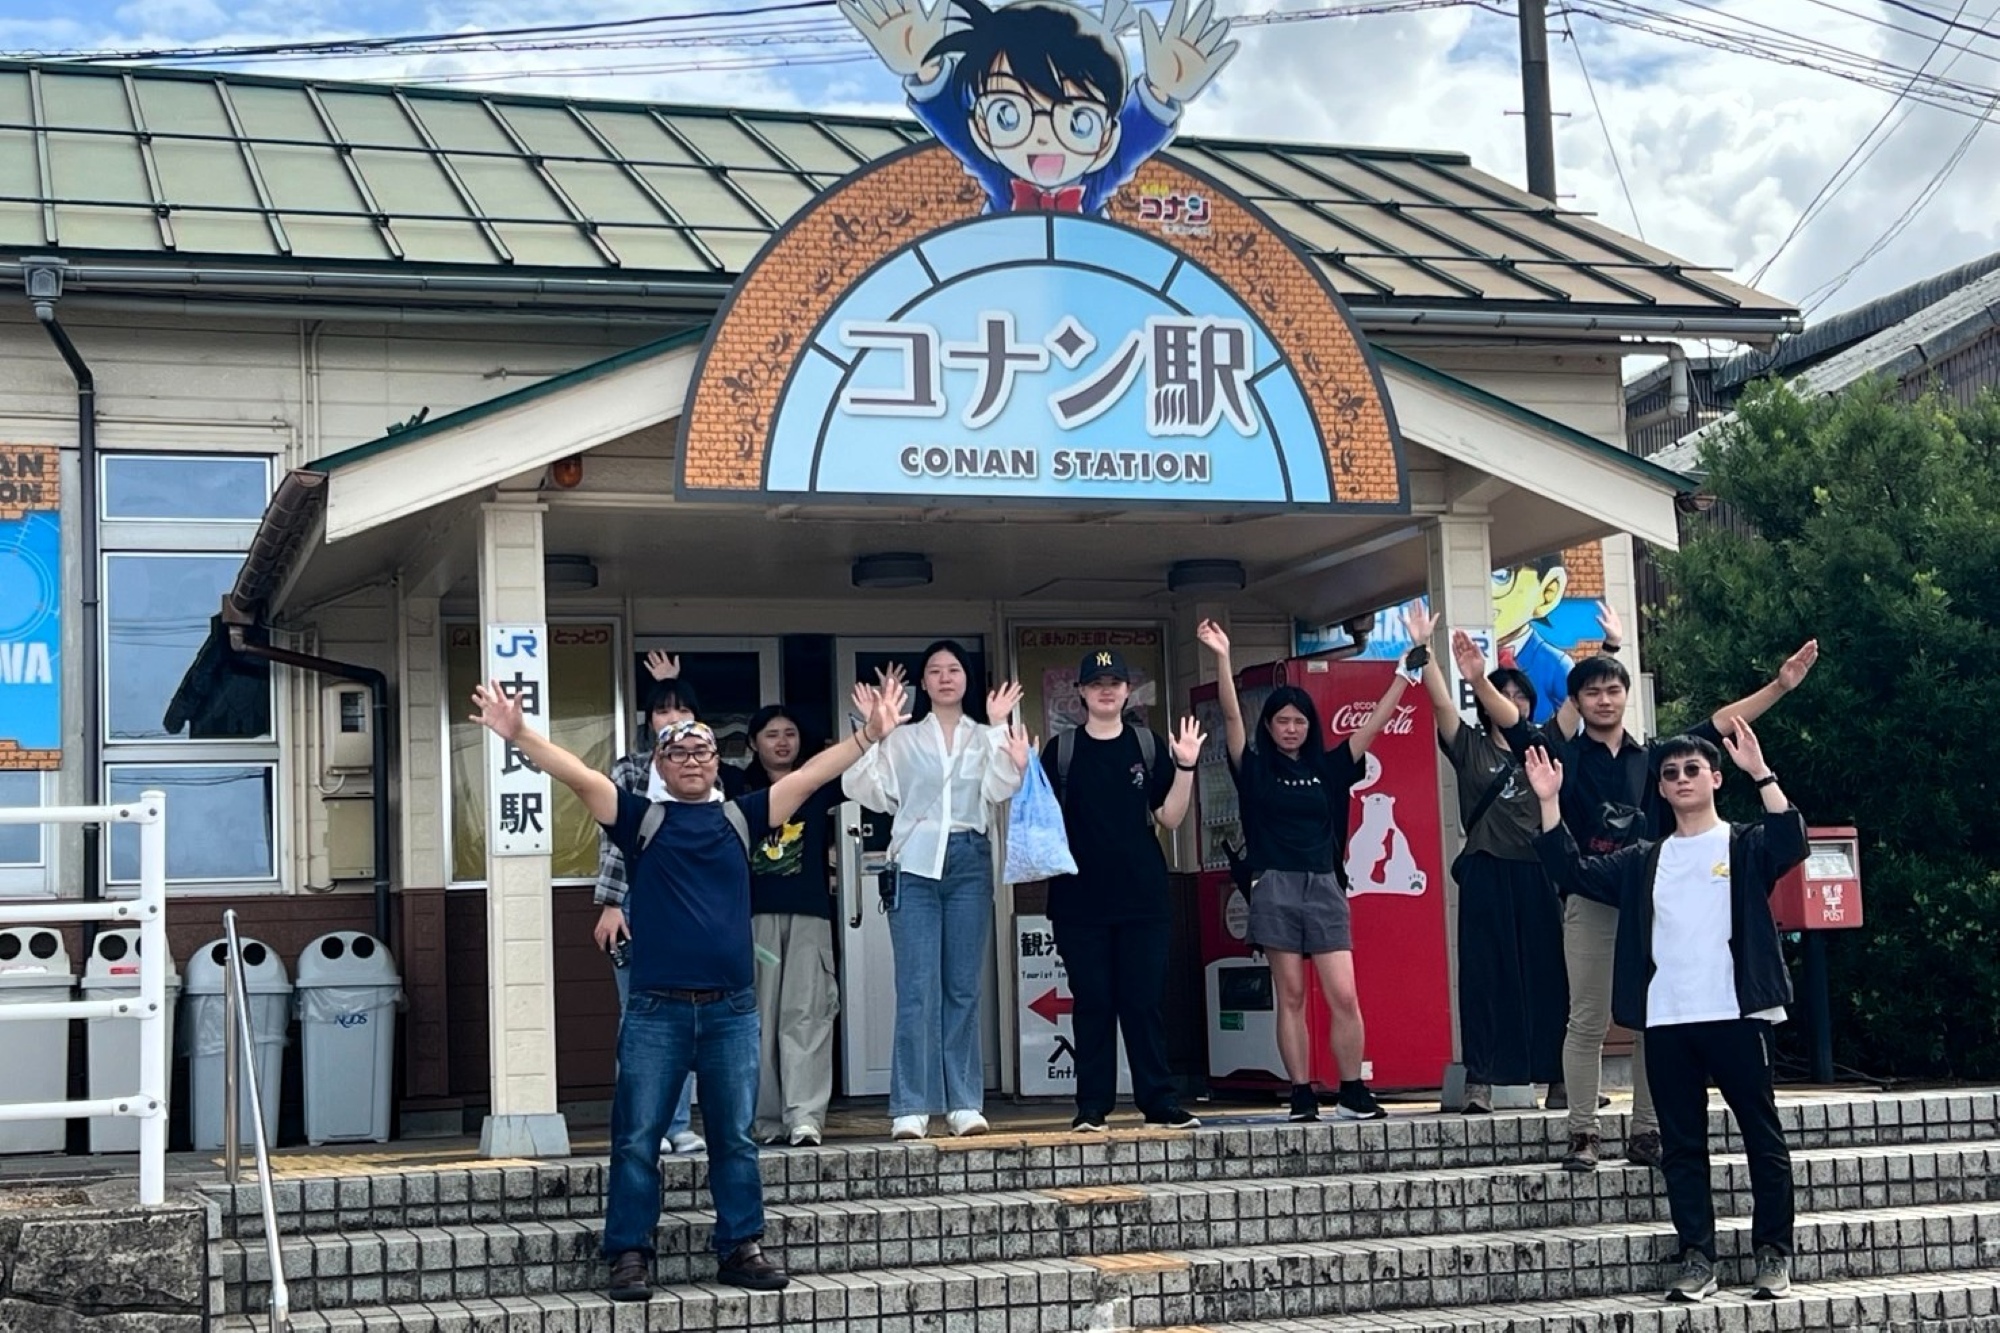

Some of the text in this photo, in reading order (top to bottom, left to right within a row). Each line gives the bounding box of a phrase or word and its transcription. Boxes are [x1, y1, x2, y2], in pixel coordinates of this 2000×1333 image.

[846, 317, 1251, 429] コナン駅
[900, 445, 1211, 482] CONAN STATION
[496, 635, 538, 658] JR
[1823, 909, 1845, 921] POST
